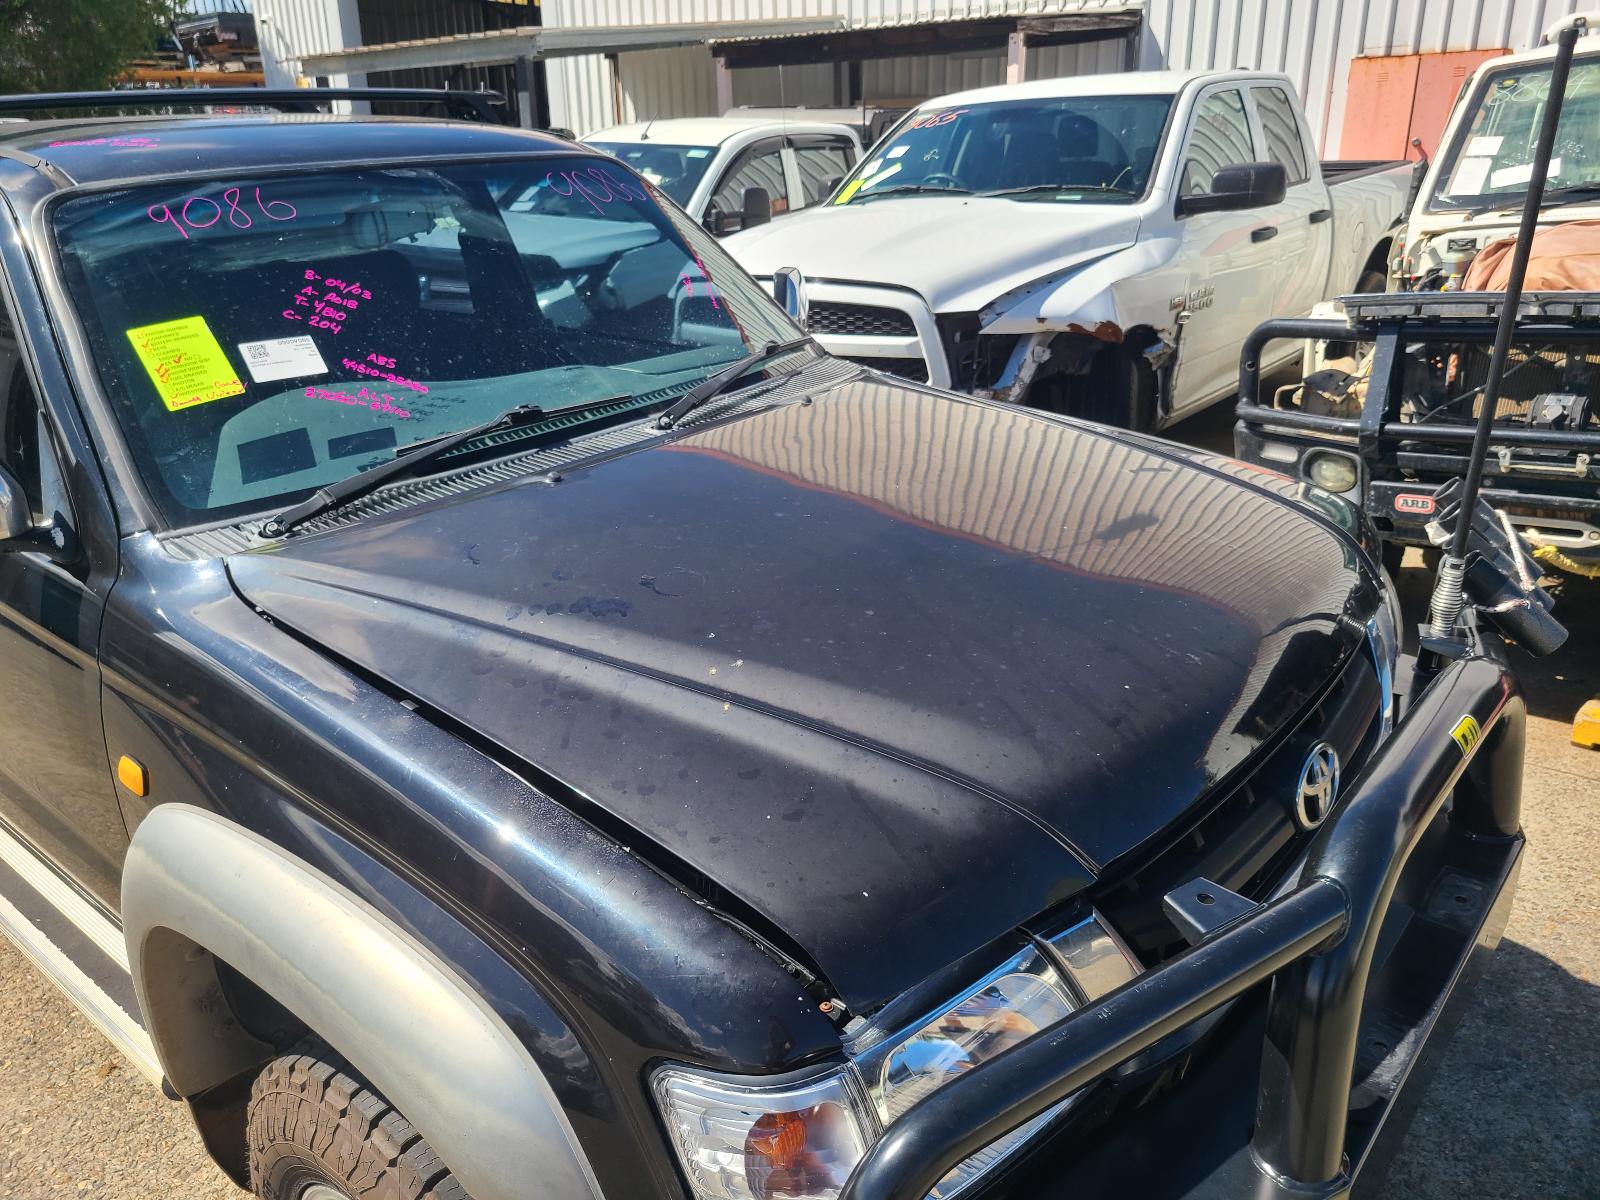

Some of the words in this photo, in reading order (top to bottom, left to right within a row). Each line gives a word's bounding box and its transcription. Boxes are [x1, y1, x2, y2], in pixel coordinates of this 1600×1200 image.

[147, 186, 297, 239] 9086
[301, 286, 319, 296] A-
[324, 278, 372, 300] 04/03
[282, 309, 303, 320] C-
[308, 315, 342, 335] 204
[367, 353, 397, 369] ABS
[1400, 498, 1430, 509] ARB
